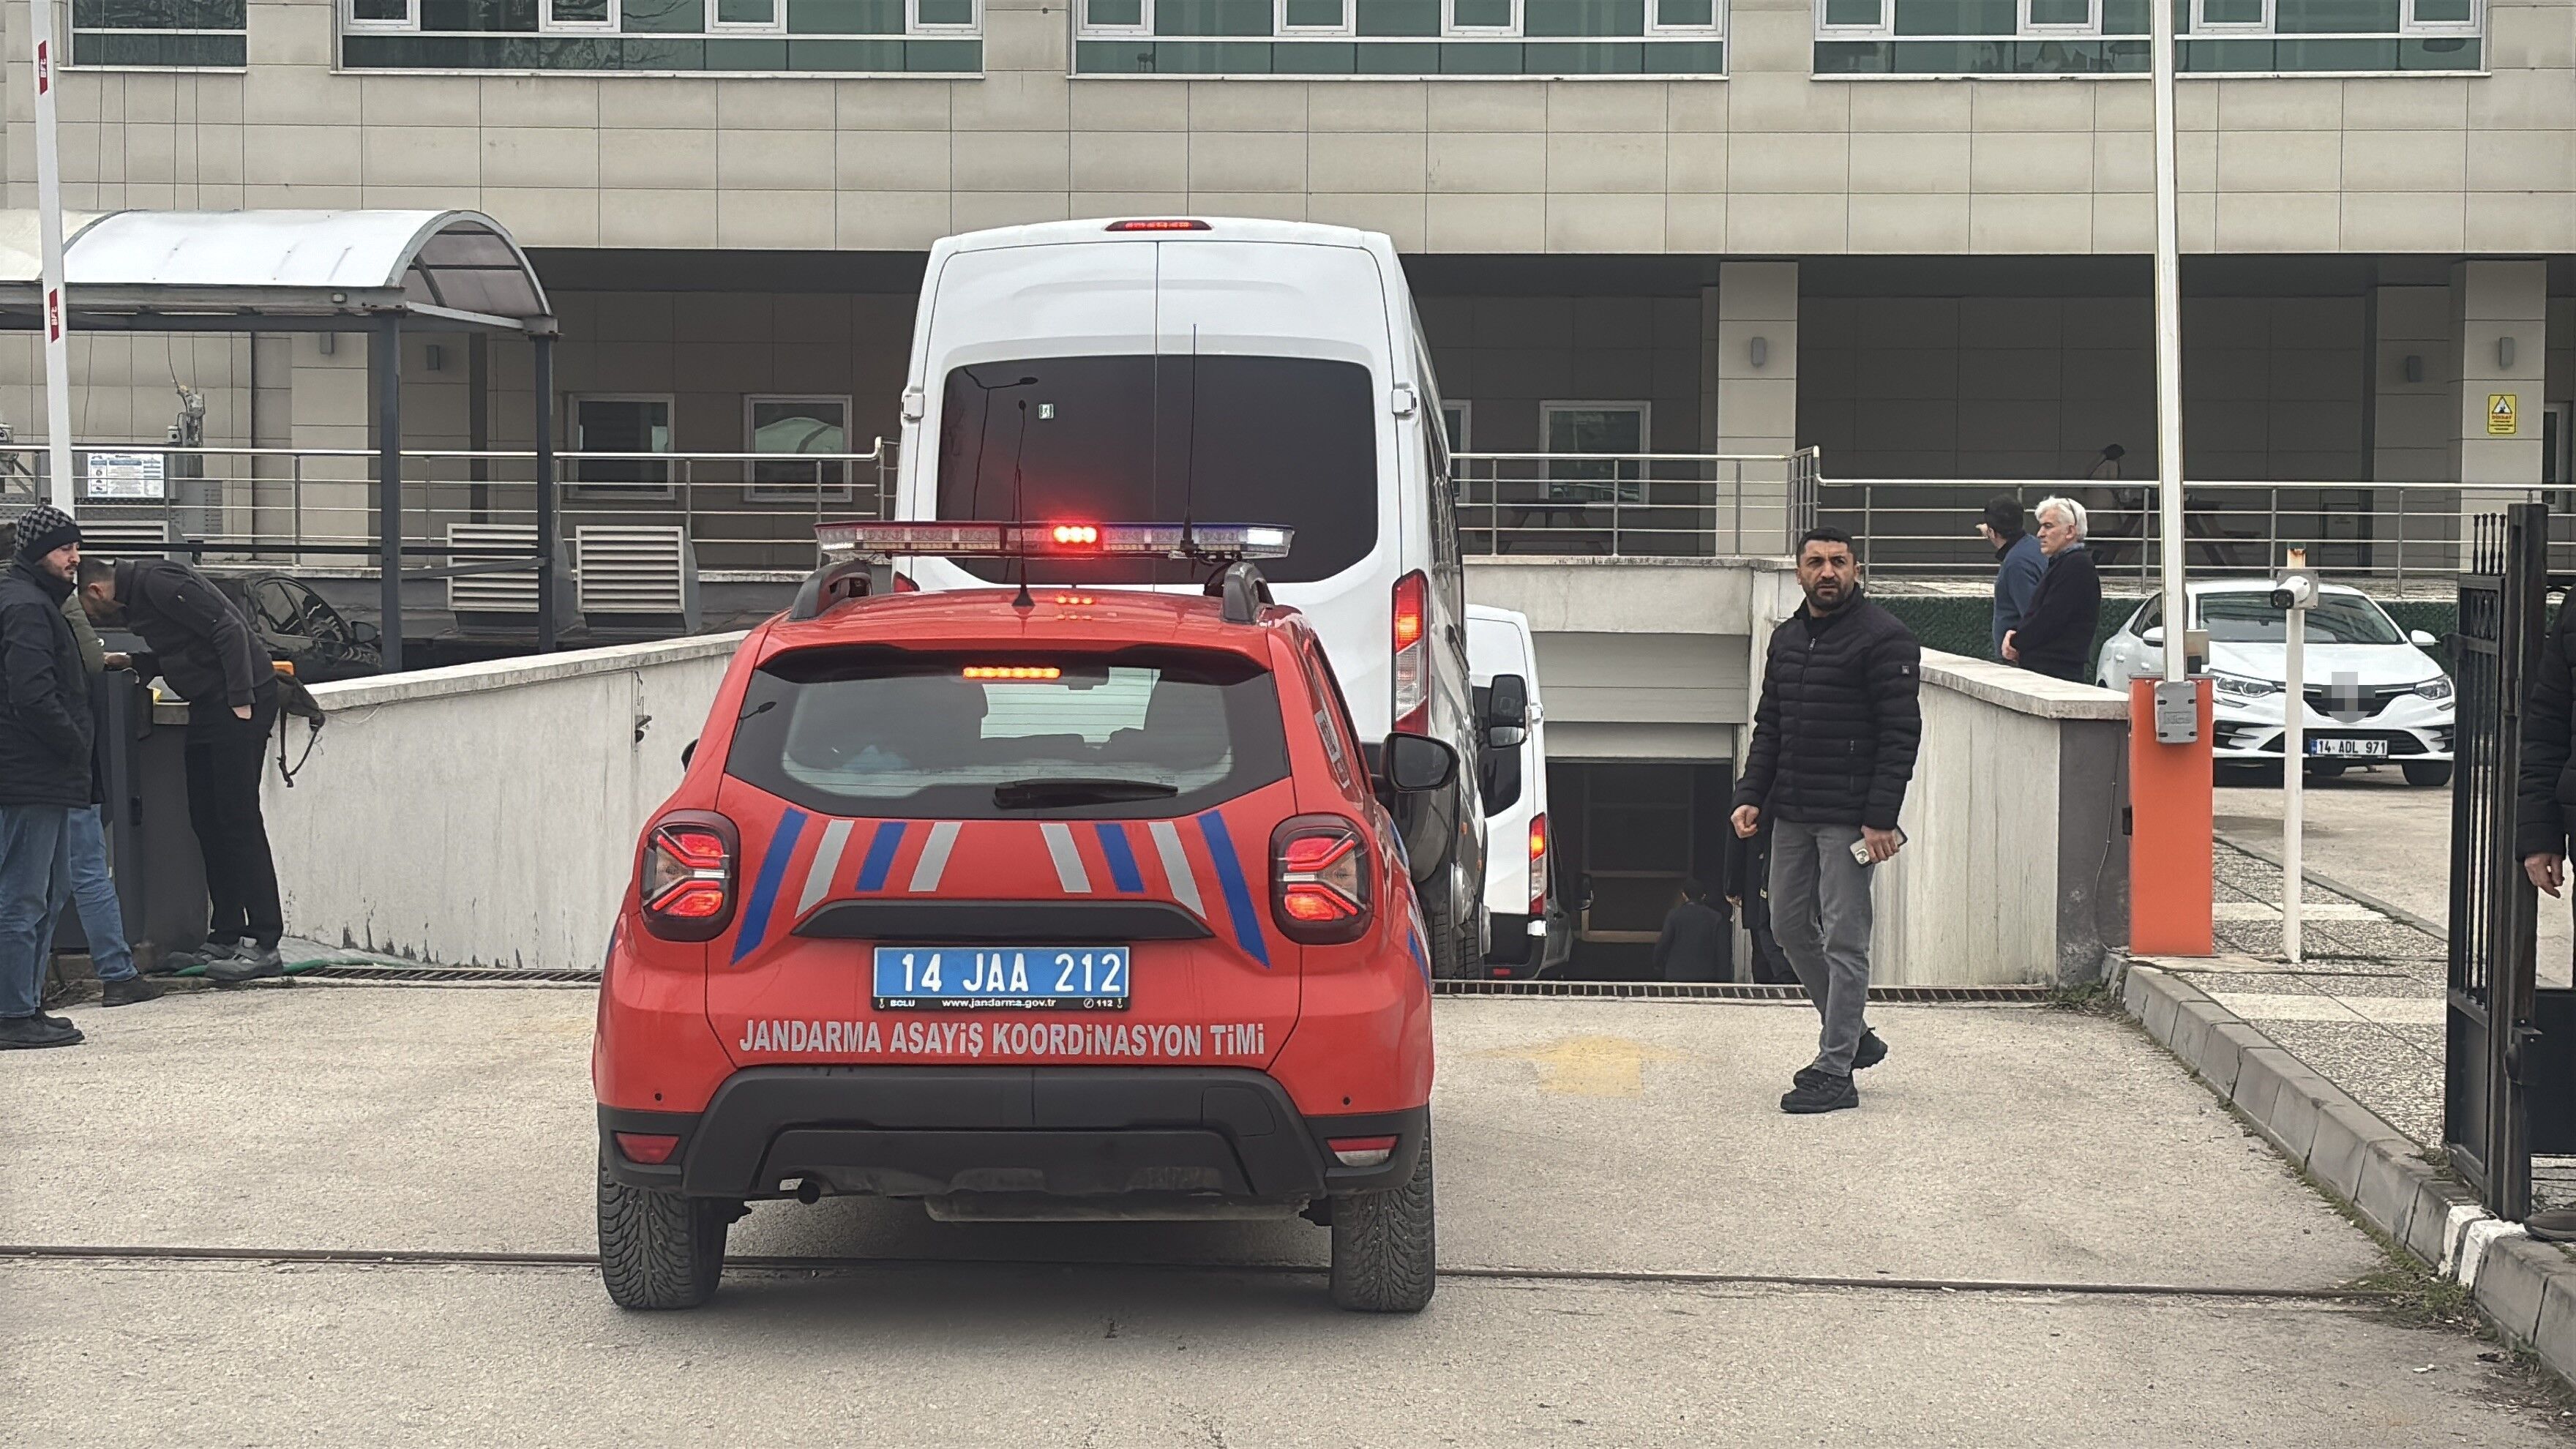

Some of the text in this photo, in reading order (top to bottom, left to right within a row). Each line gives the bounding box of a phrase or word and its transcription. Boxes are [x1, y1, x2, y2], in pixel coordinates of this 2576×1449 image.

[2319, 741, 2331, 753] 14
[2366, 741, 2385, 753] 971
[902, 953, 1120, 992] 14 JAA 212
[942, 998, 1056, 1008] www.jandarma.gov.tr
[1096, 999, 1113, 1007] 112
[739, 1019, 881, 1052] JANDARMA
